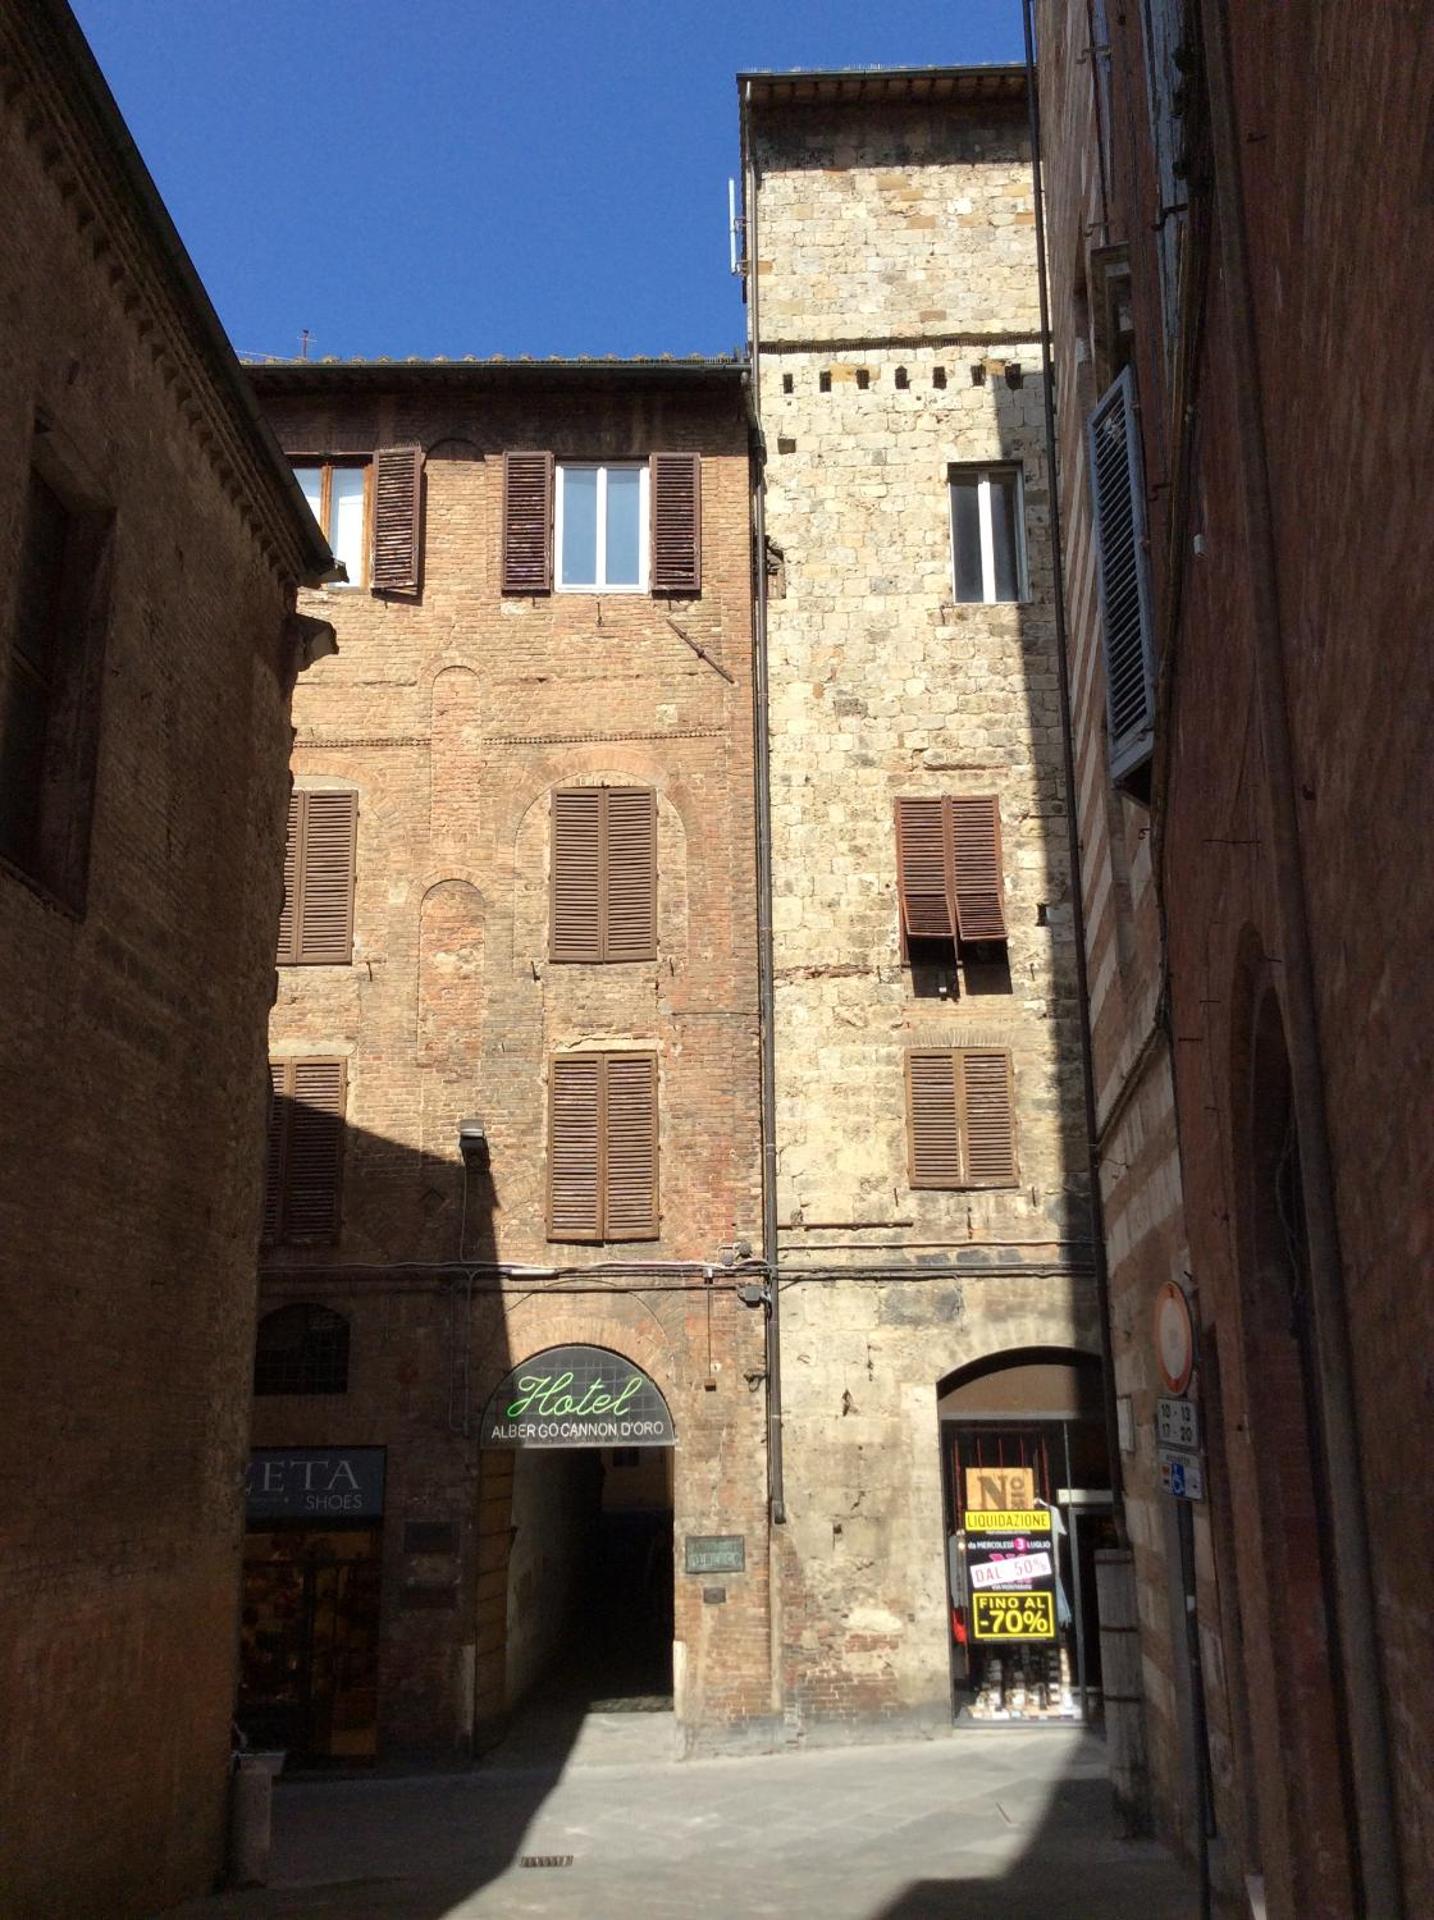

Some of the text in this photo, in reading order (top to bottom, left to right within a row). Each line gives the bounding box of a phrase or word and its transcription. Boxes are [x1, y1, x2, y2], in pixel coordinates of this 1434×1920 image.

[507, 1372, 643, 1417] Hotel
[560, 1422, 617, 1437] CANNON
[620, 1421, 664, 1436] D'ORO
[246, 1460, 362, 1492] ETA
[306, 1494, 363, 1511] SHOES
[967, 1513, 1048, 1528] LIQUIDAZIONE
[975, 1558, 1047, 1583] DAL 50%
[979, 1597, 1046, 1609] FINO AL
[980, 1610, 1048, 1633] -70%
